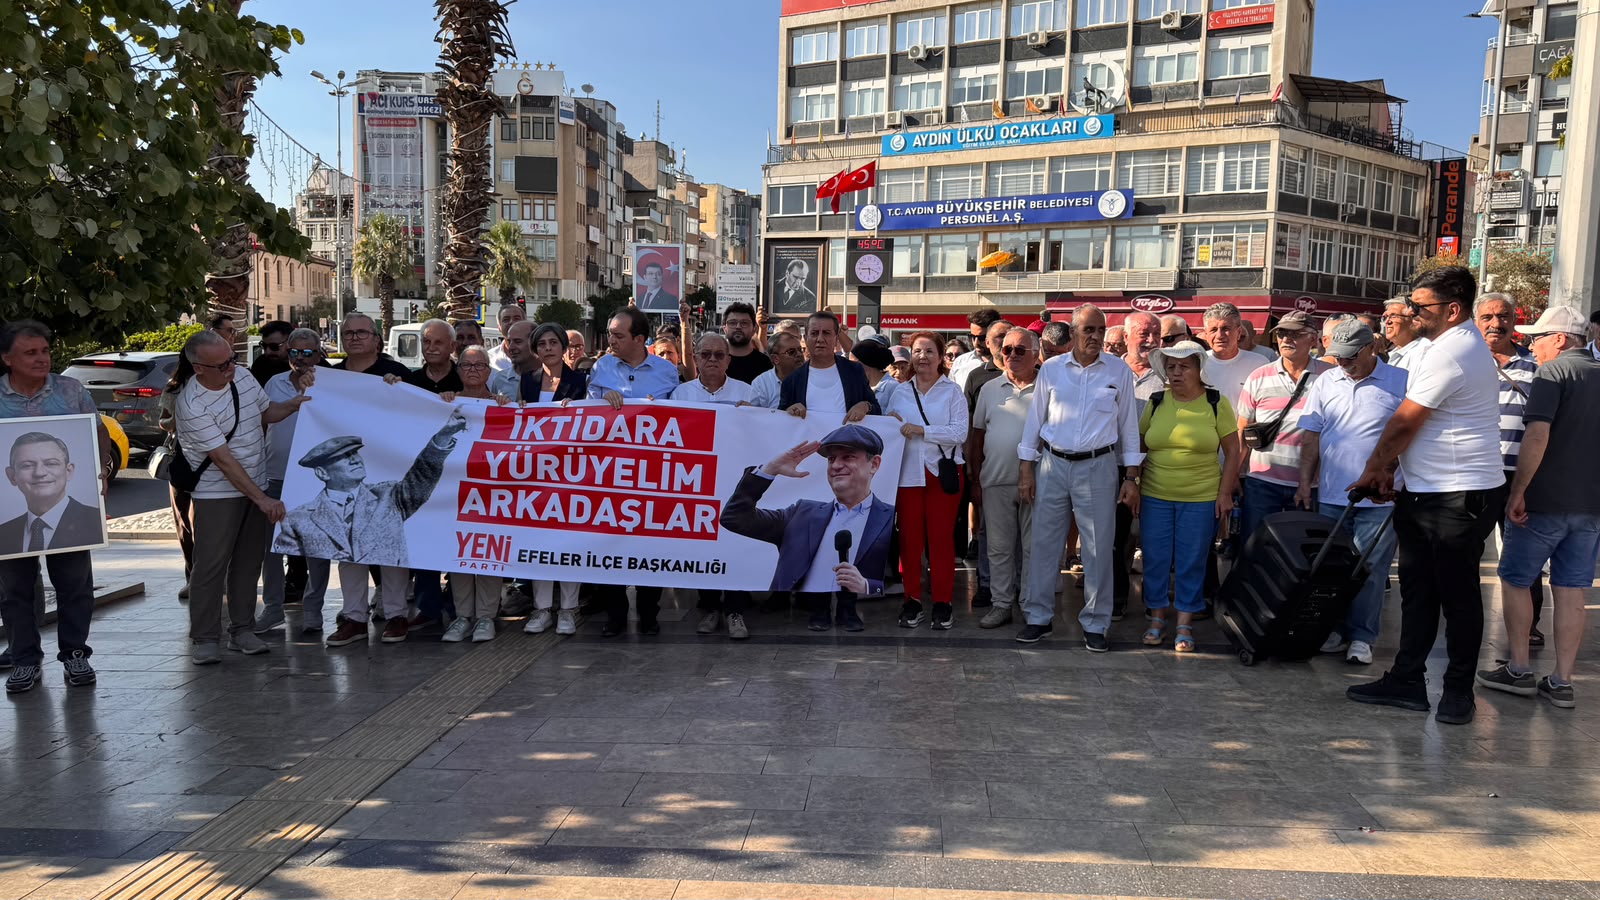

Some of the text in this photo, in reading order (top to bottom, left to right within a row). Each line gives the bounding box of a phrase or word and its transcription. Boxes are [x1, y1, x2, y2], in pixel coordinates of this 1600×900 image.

[389, 95, 415, 108] KURS
[912, 120, 1077, 147] AYDIN ÜLKÜ OCAKLARI
[887, 196, 1093, 217] T.C. AYDIN BÜYÜKŞEHİR BELEDİYESİ
[1441, 160, 1460, 236] Perande
[941, 212, 1024, 225] PERSONEL A.Ş.
[509, 408, 685, 448] İKTİDARA
[485, 445, 703, 493] YÜRÜYELİM
[460, 487, 718, 534] ARKADAŞLAR
[456, 531, 727, 575] YENİ EFELER İLÇE BAŞKANLIĞI
[459, 561, 505, 572] PARTİ
